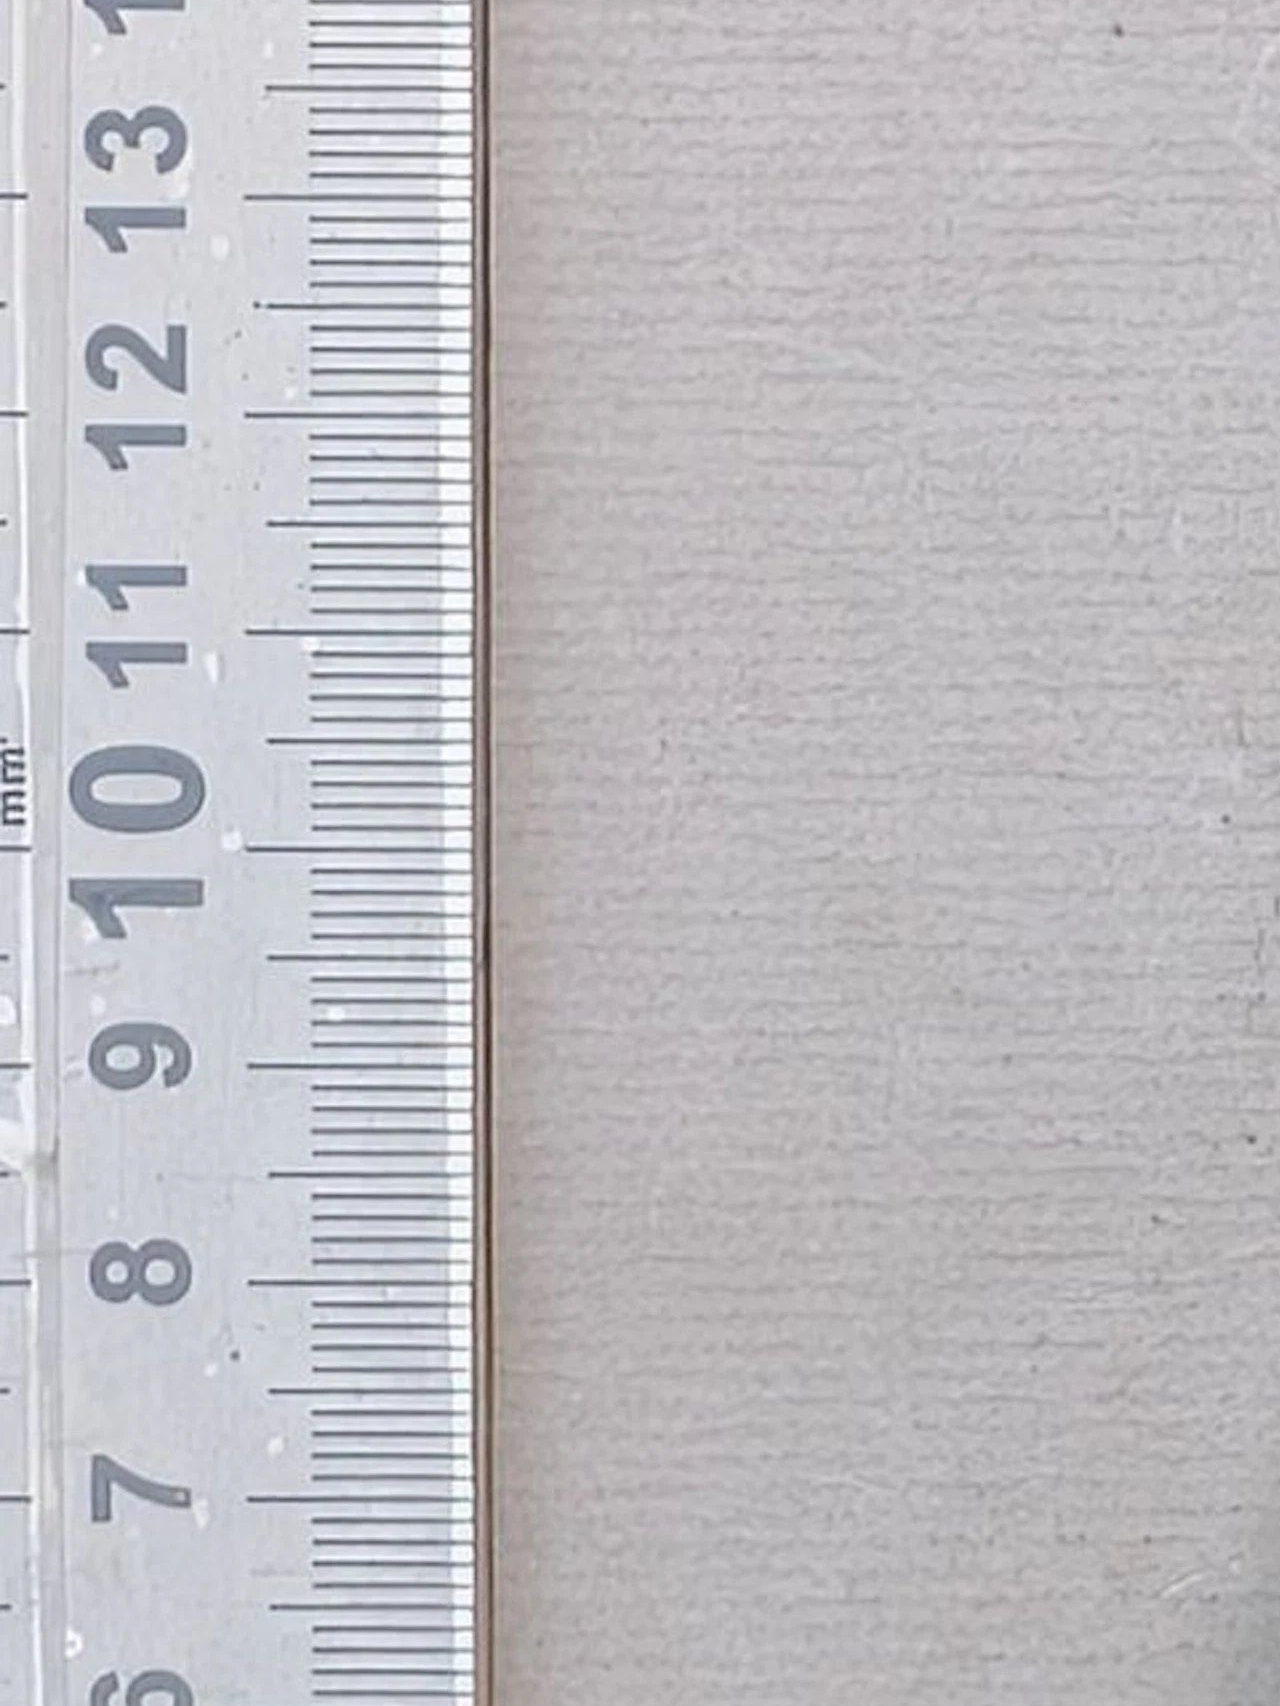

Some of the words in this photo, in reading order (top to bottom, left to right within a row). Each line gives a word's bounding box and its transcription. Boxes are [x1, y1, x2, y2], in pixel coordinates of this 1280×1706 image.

[84, 105, 188, 254] 13
[84, 324, 188, 470] 12
[85, 566, 188, 689] 11
[68, 745, 206, 939] 10
[88, 1022, 192, 1090] 9
[88, 1239, 192, 1306] 8
[91, 1455, 191, 1521] 7
